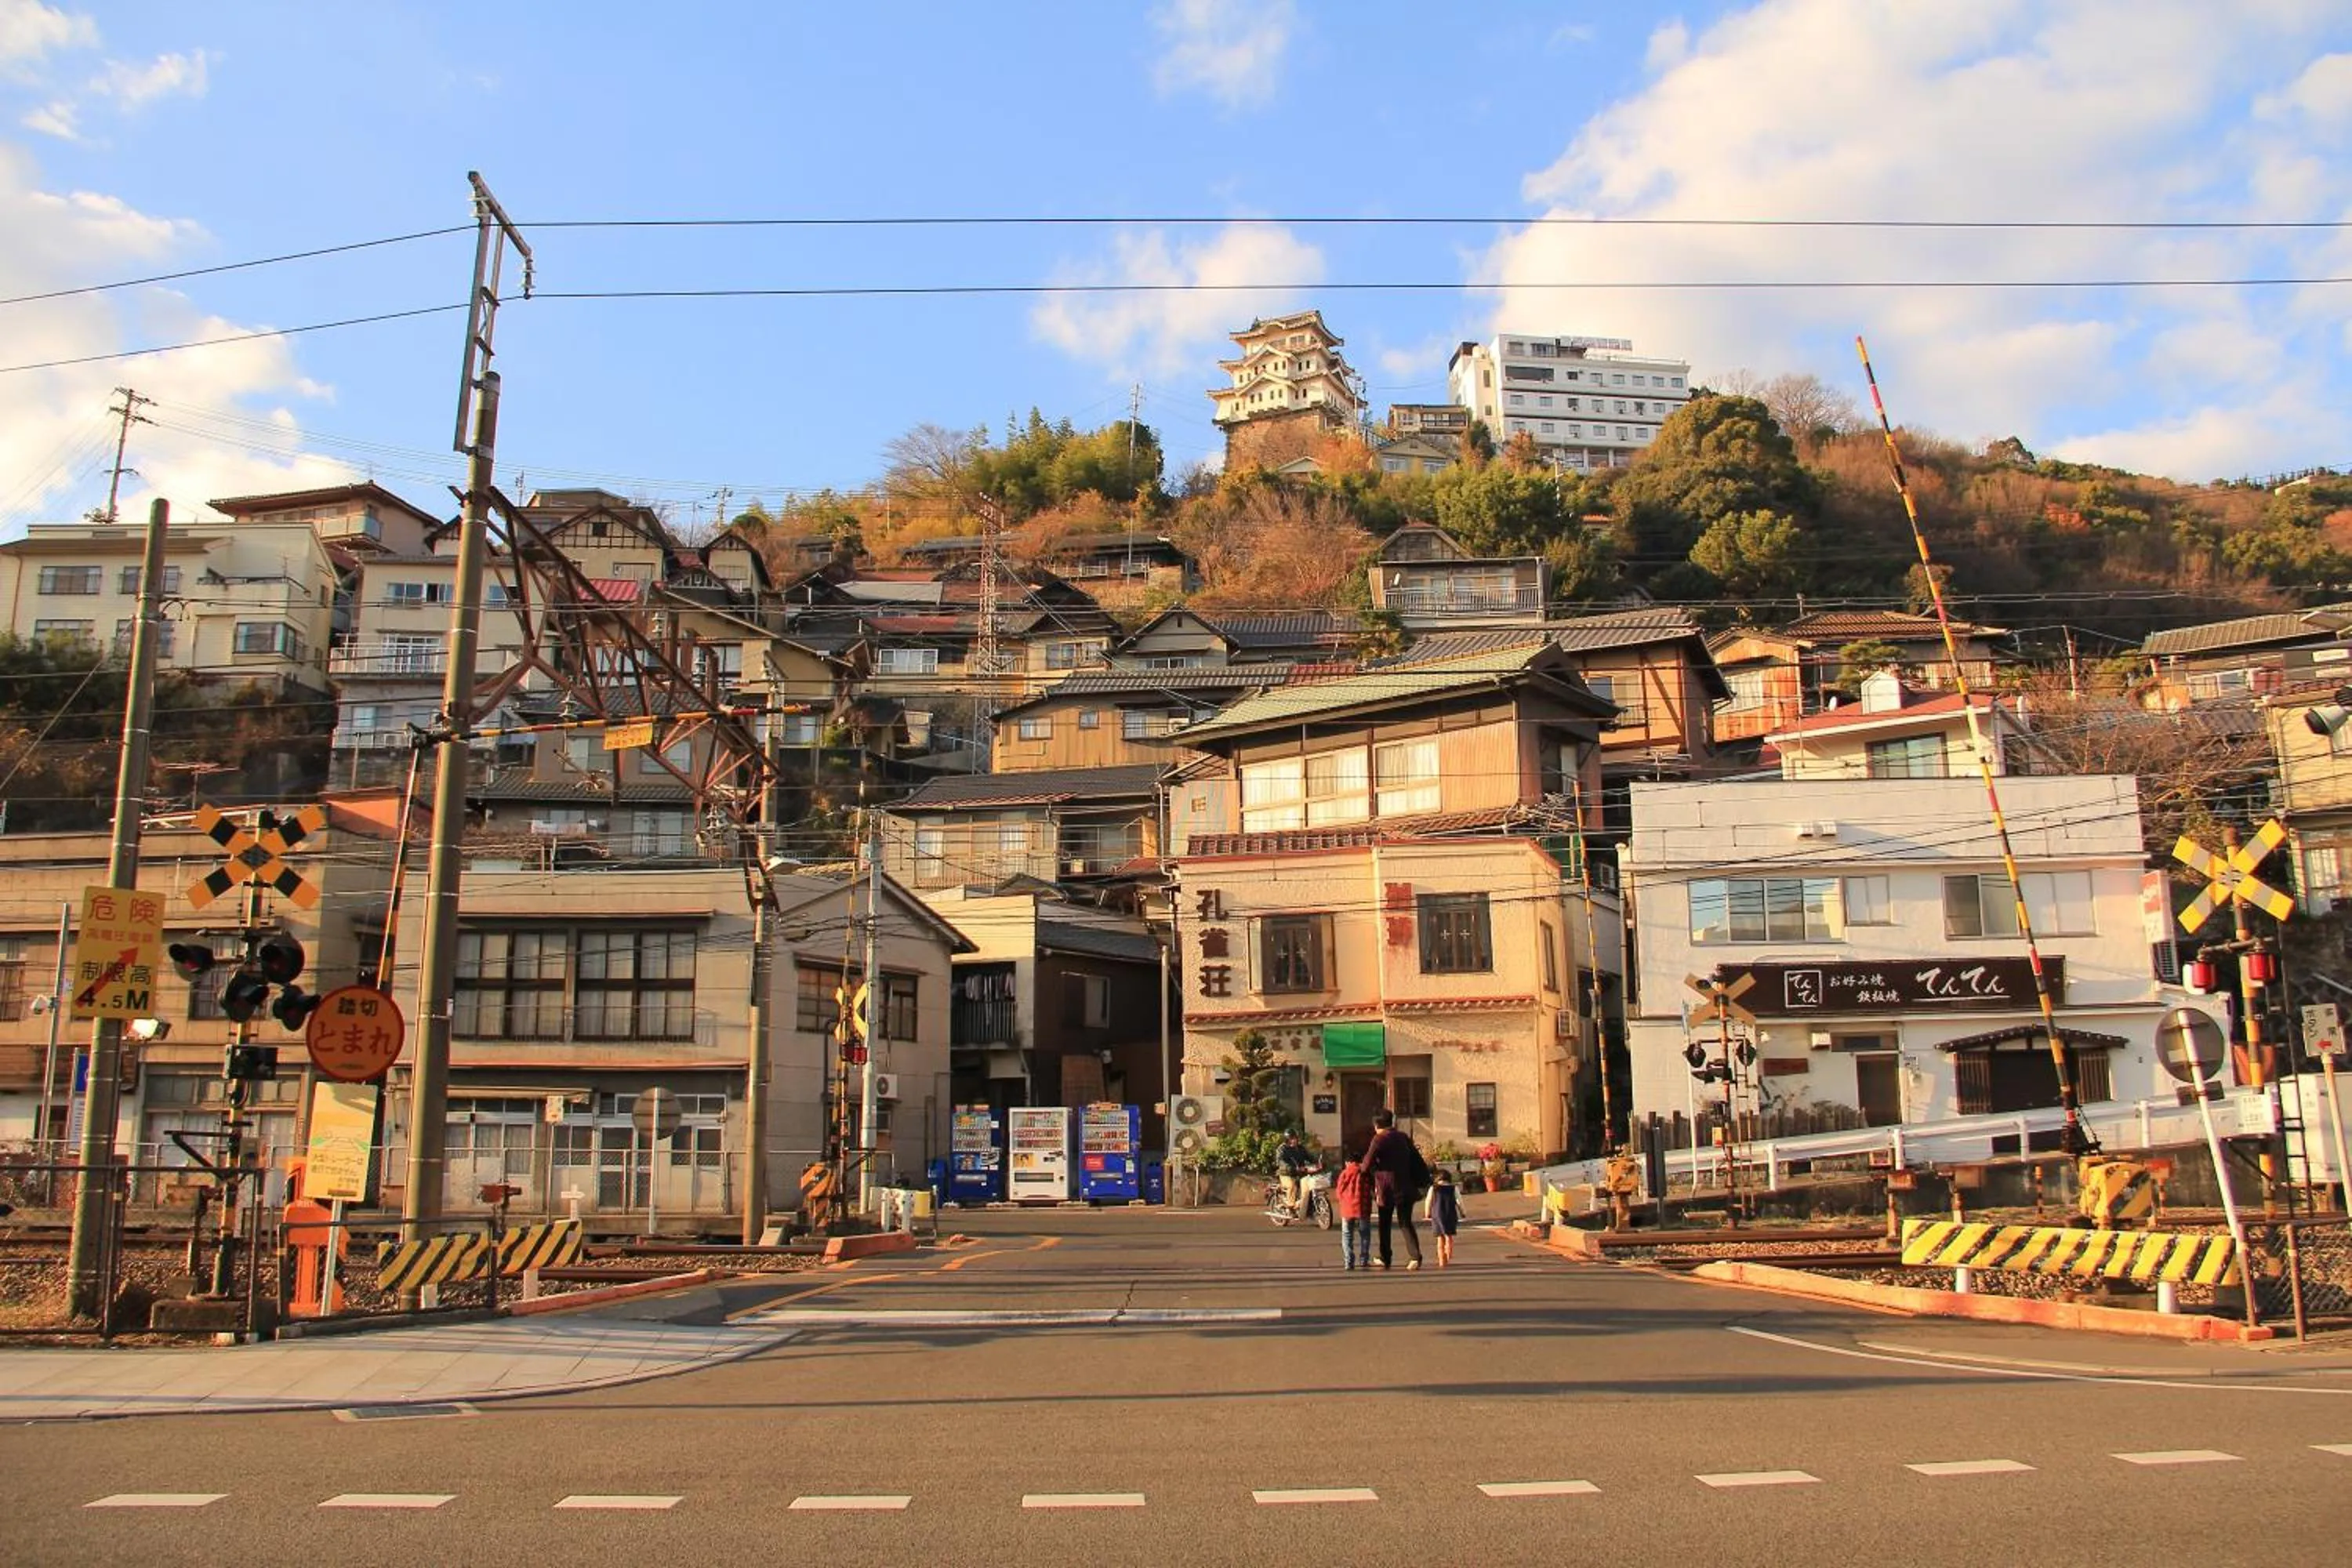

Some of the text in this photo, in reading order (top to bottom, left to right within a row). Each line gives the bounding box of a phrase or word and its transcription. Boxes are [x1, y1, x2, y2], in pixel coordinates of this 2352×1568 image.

[89, 895, 160, 927] 危険
[1196, 889, 1232, 997] 孔雀荘
[1830, 973, 1886, 988] お好み焼
[1915, 966, 2005, 995] てんてん
[82, 989, 149, 1010] 4.5M
[338, 996, 379, 1017] 踏切
[1857, 989, 1900, 1004] 鉄板焼
[314, 1022, 394, 1055] とまれ
